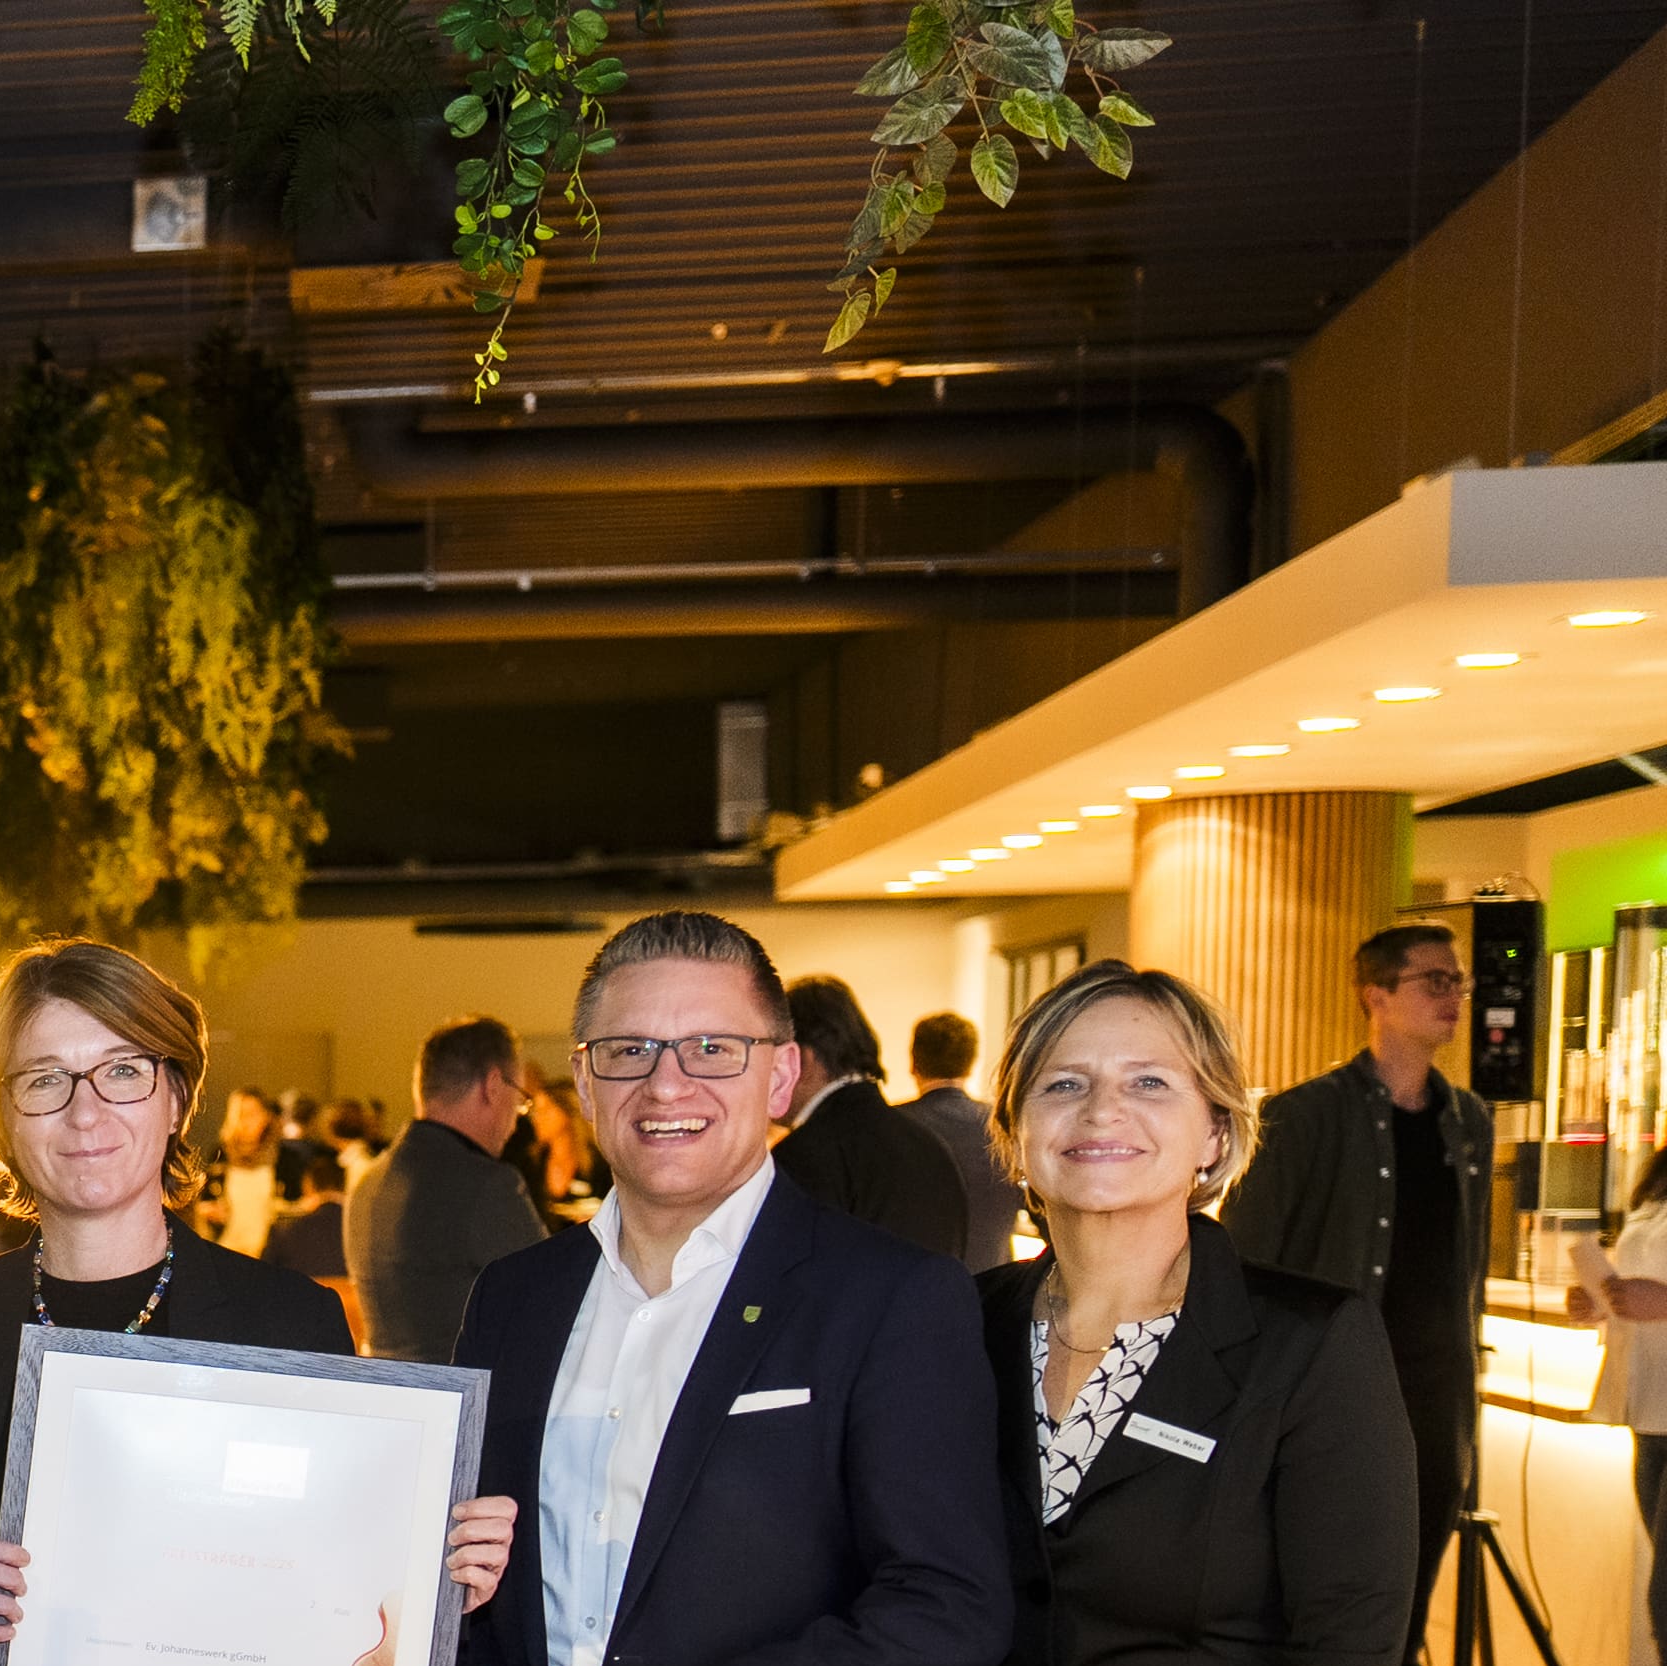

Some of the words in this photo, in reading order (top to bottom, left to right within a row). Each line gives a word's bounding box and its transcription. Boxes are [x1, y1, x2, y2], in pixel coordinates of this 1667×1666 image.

[145, 1641, 161, 1652] Ev.
[160, 1643, 228, 1659] Johanneswerk
[229, 1652, 268, 1664] gGmbH
